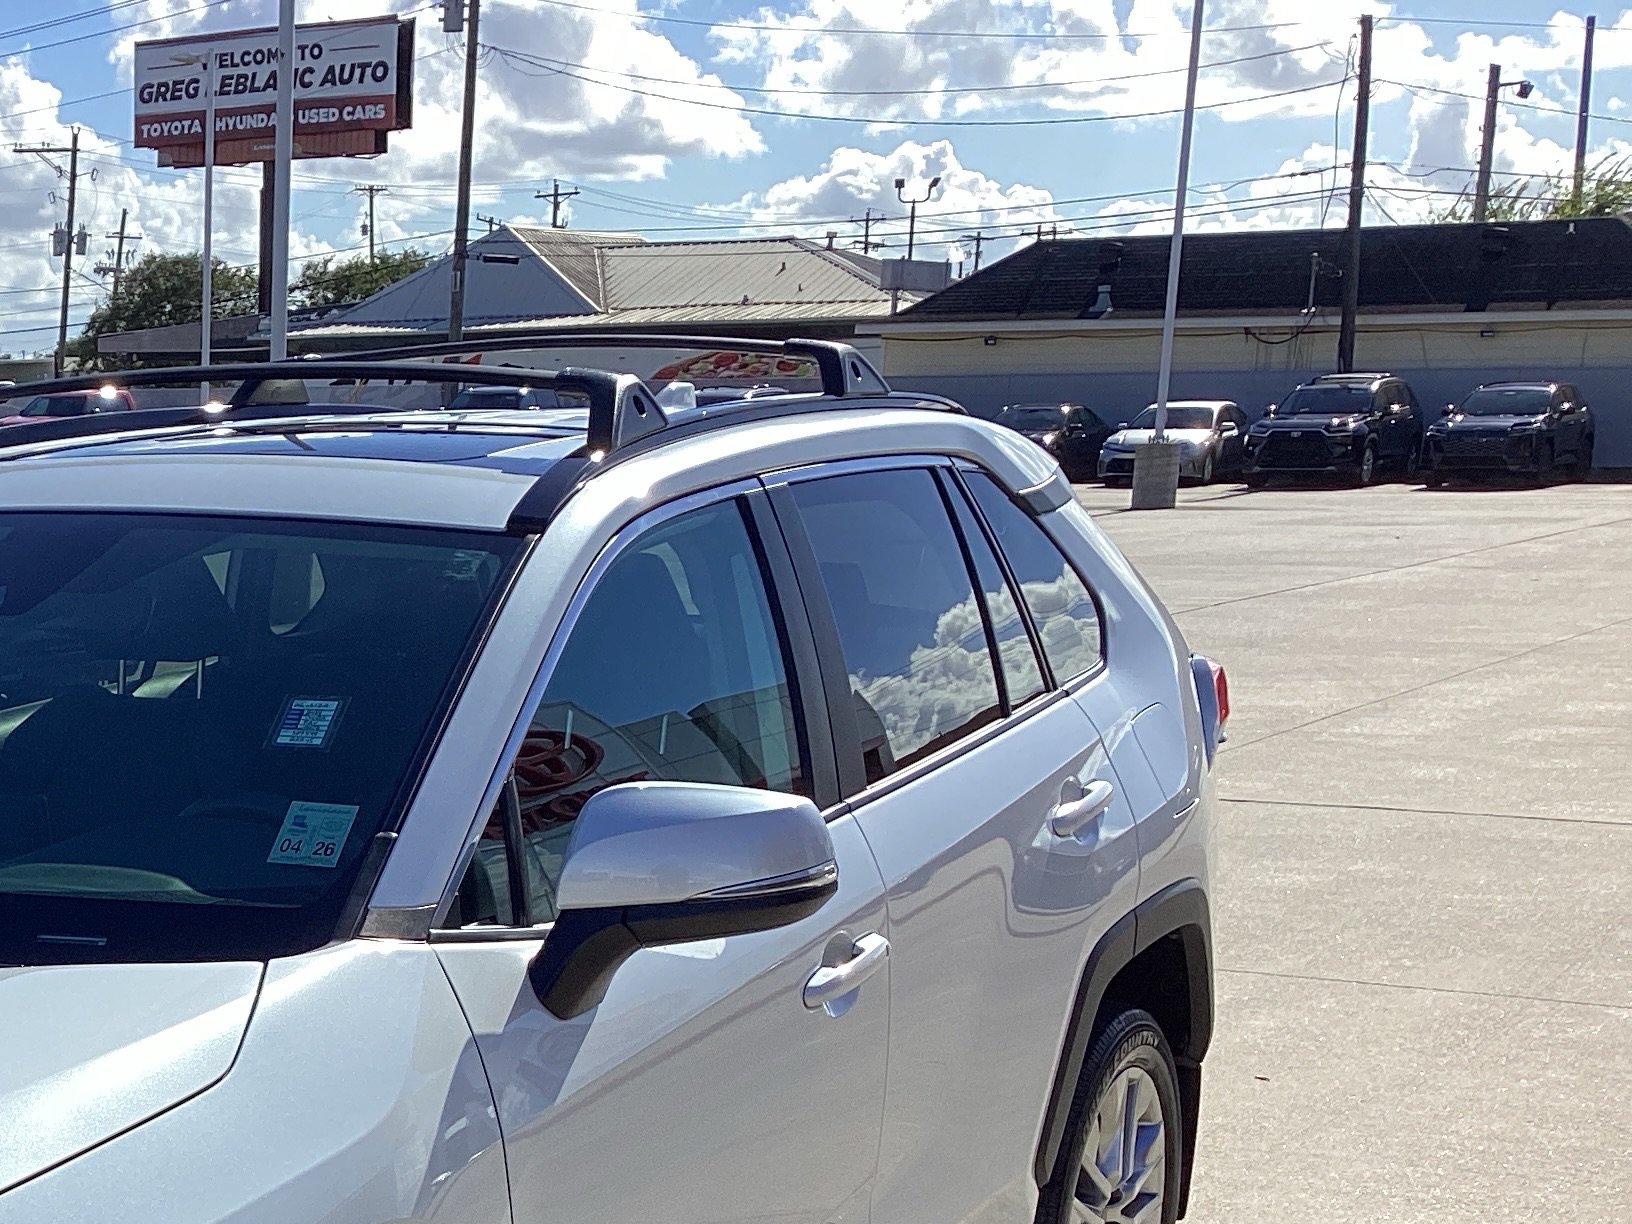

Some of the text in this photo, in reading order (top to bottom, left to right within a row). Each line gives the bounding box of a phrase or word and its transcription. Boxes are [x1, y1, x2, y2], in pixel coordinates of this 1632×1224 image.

[201, 43, 323, 70] ELCOM TO
[139, 60, 389, 104] GREG EBLAC AUTO
[141, 103, 385, 138] TOYOTA HYUNDA USED CARS
[279, 838, 336, 857] 04 26
